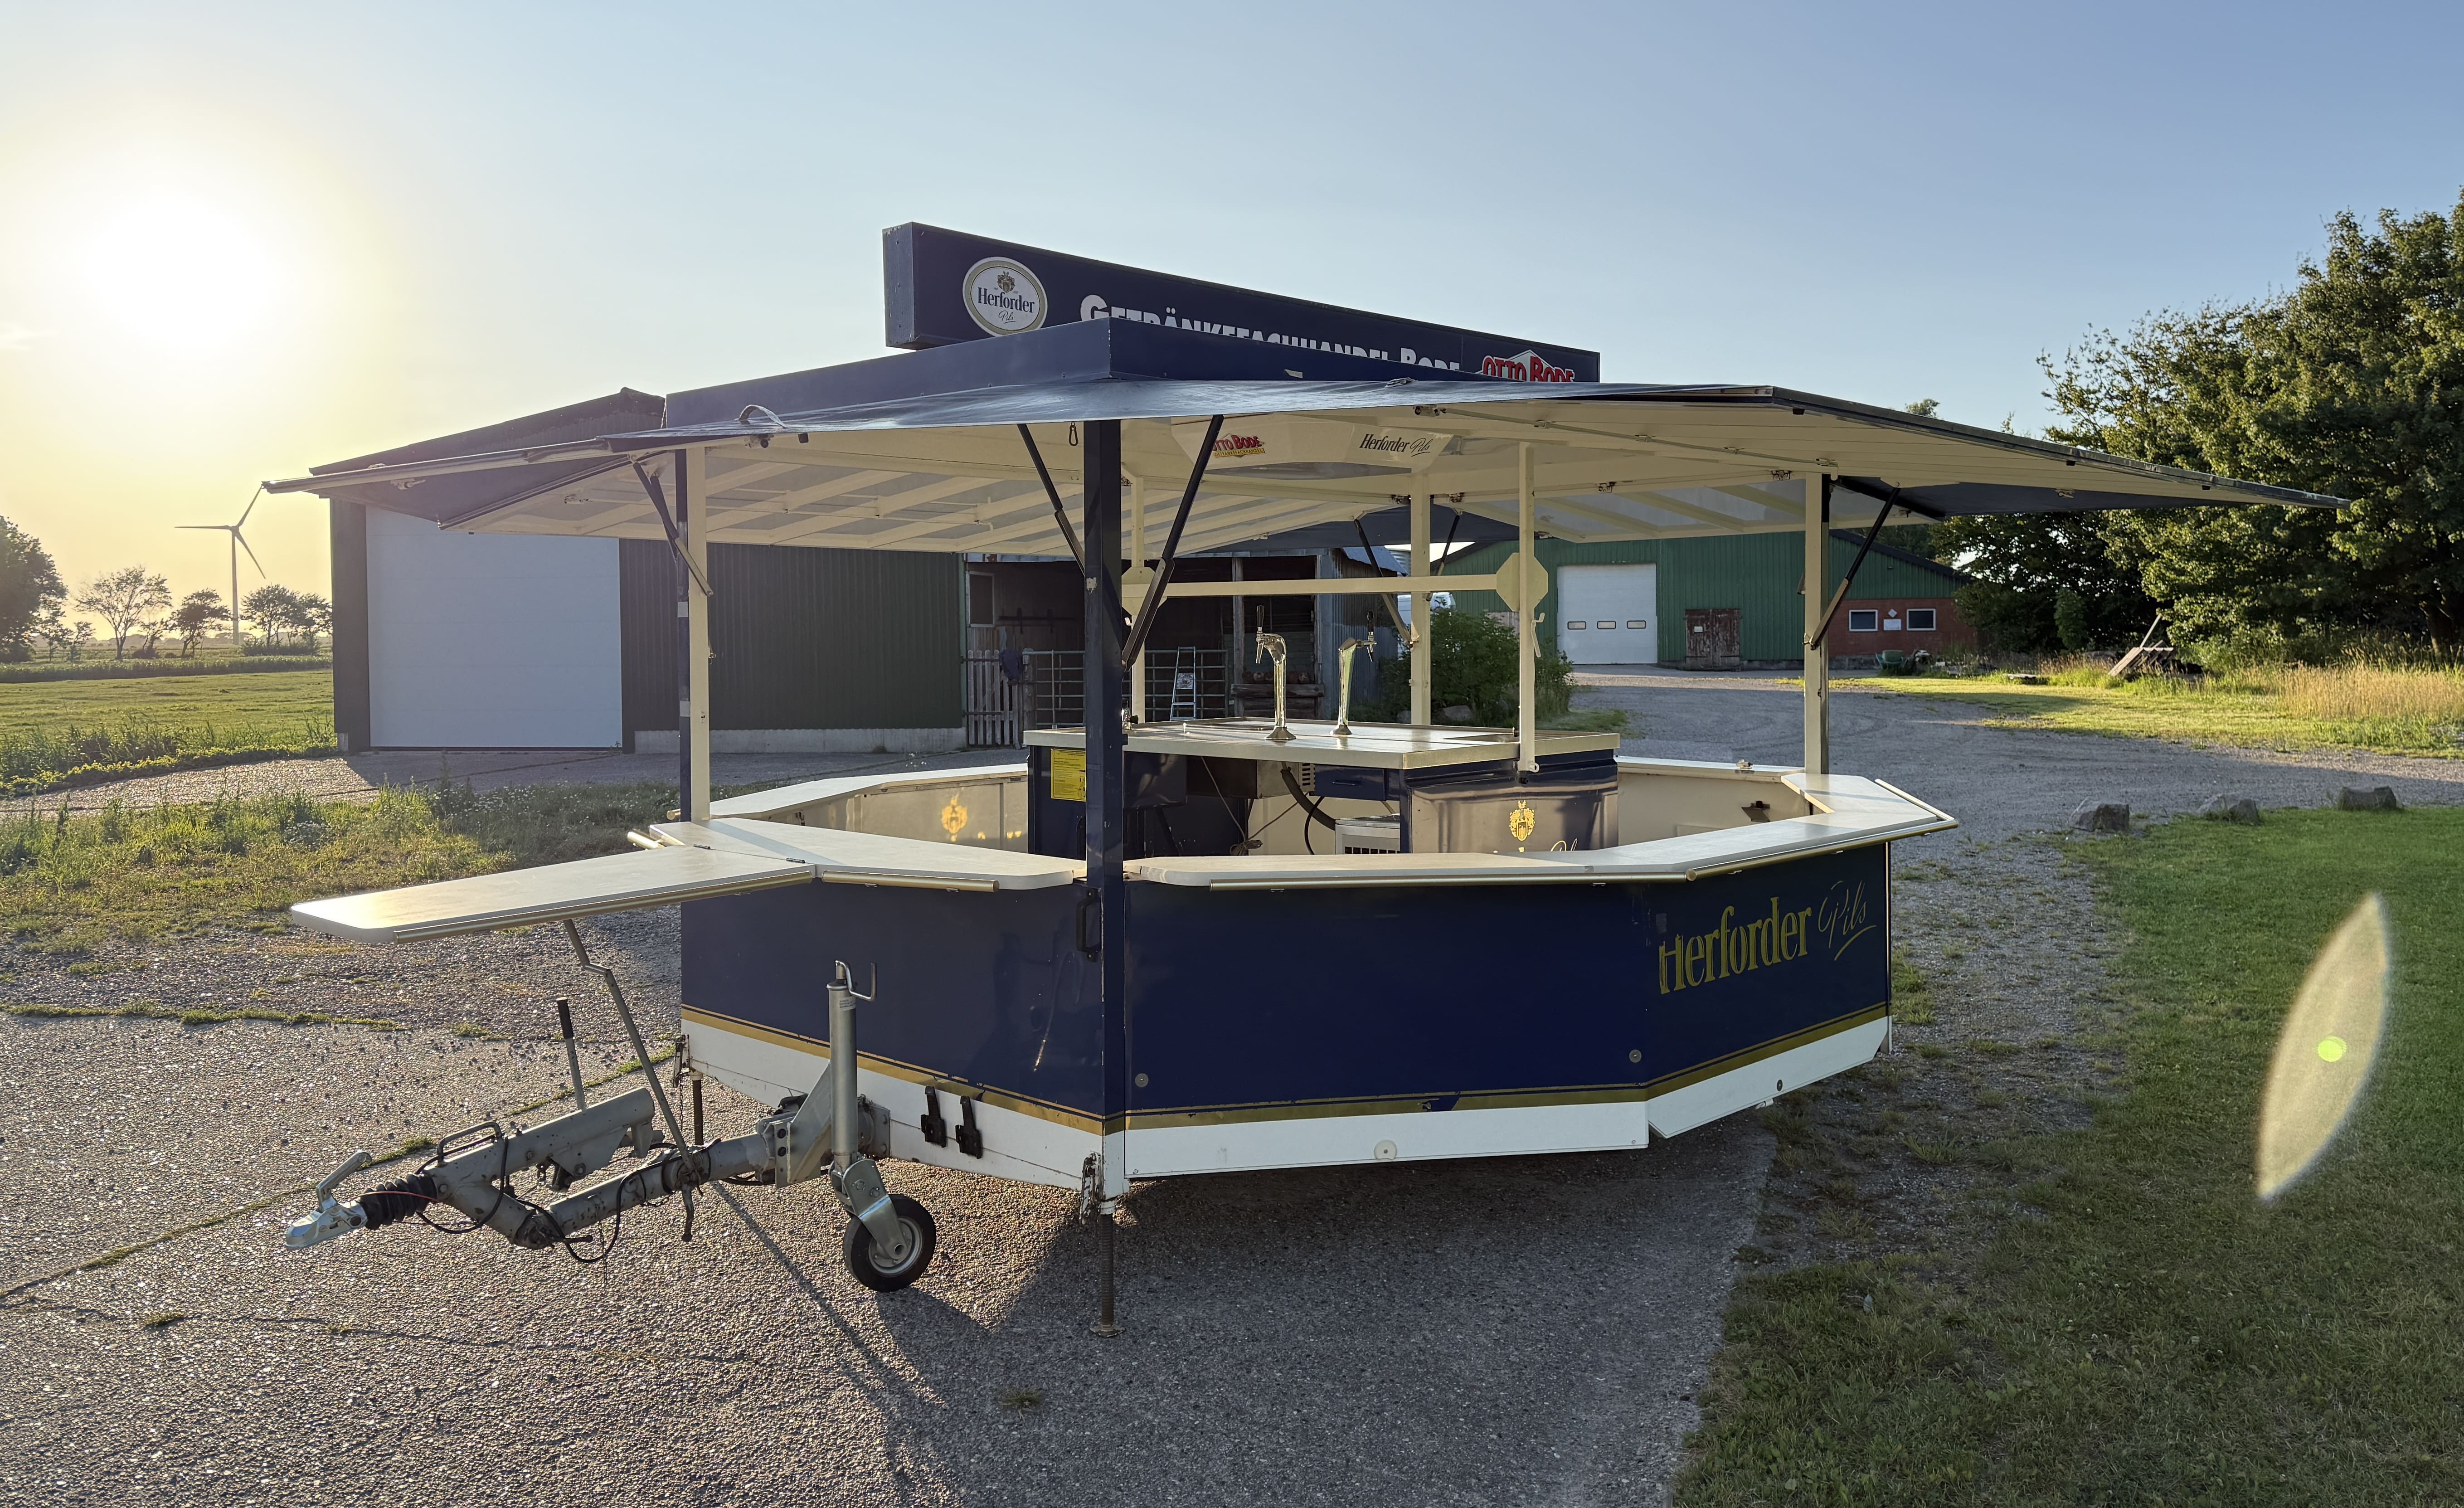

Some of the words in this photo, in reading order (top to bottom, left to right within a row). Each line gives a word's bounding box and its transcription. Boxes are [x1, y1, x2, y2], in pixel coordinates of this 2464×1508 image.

[977, 287, 1035, 313] Herforder
[998, 310, 1015, 322] Pils
[1359, 433, 1410, 452] Herforder
[1410, 437, 1434, 455] Pils
[1658, 896, 1812, 995] Herforder
[1817, 880, 1870, 952] Pils
